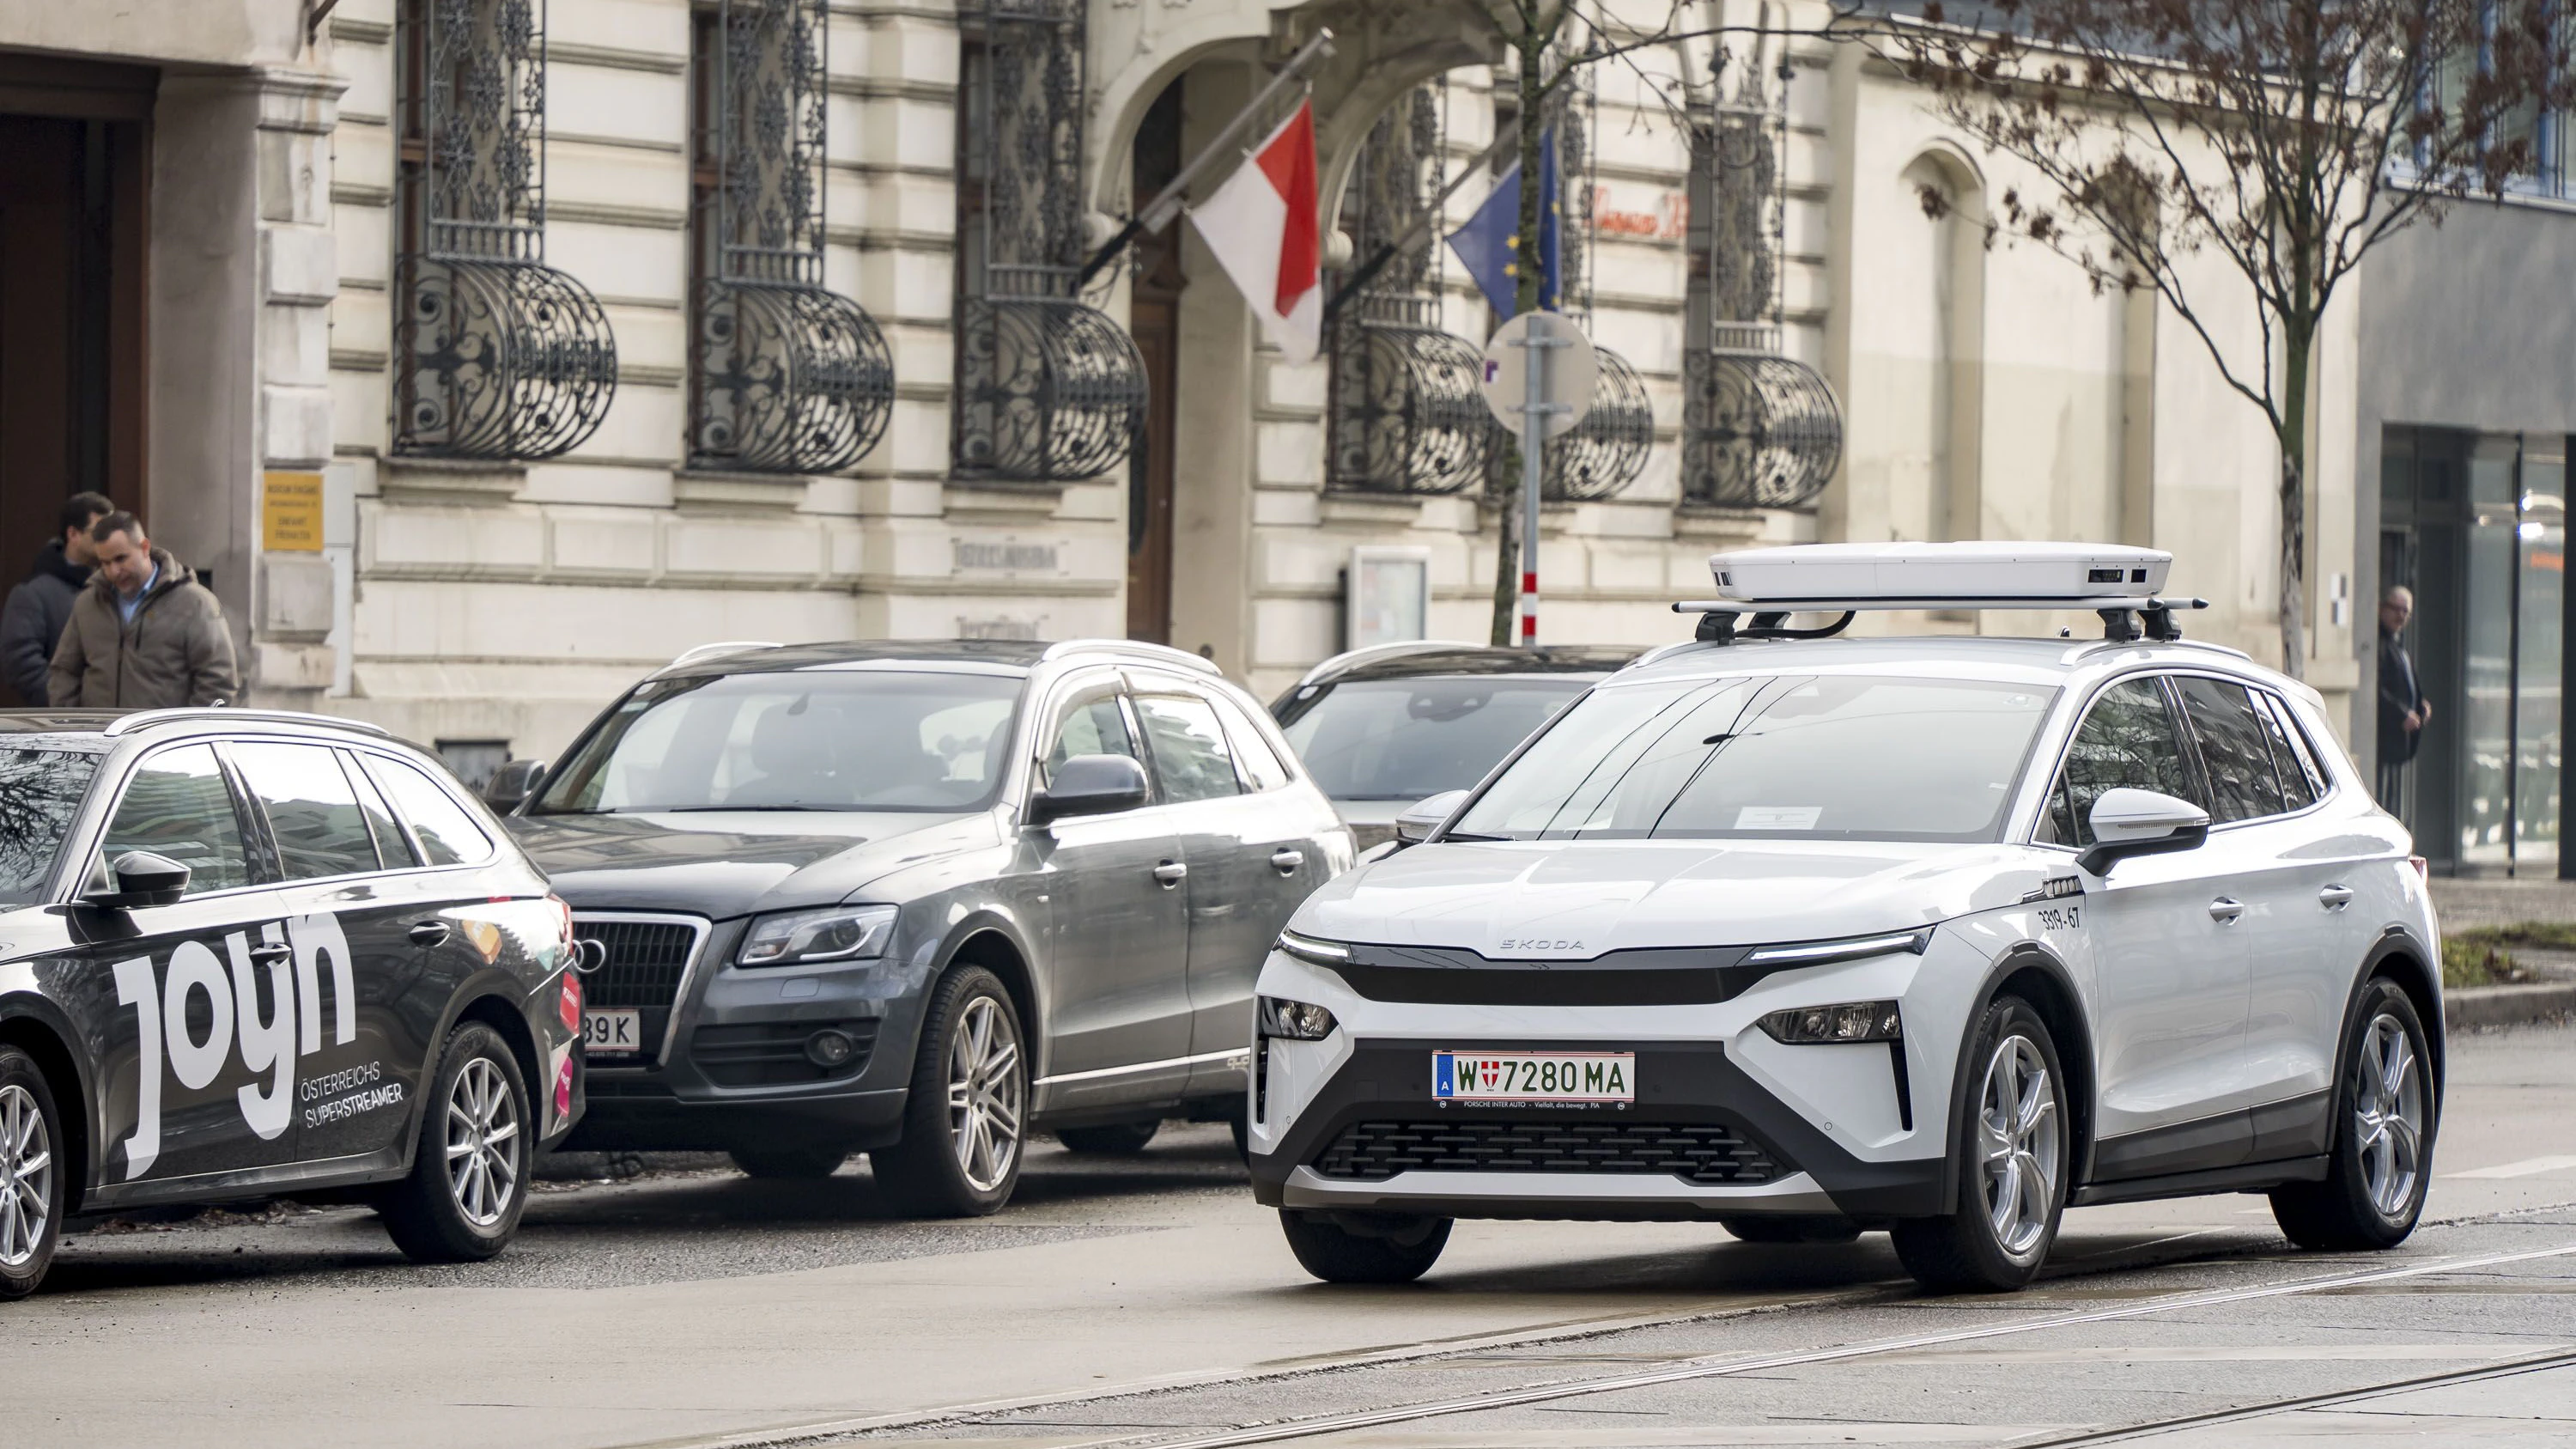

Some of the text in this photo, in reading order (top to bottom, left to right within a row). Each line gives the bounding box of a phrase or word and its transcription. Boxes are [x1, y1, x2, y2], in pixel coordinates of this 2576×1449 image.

[2038, 906, 2080, 930] 3319-67
[301, 1061, 380, 1102] ÖSTERREICHS
[1441, 1081, 1449, 1091] A
[1457, 1060, 1625, 1093] W 7280 MA
[305, 1082, 404, 1129] SUPERSTREAMER
